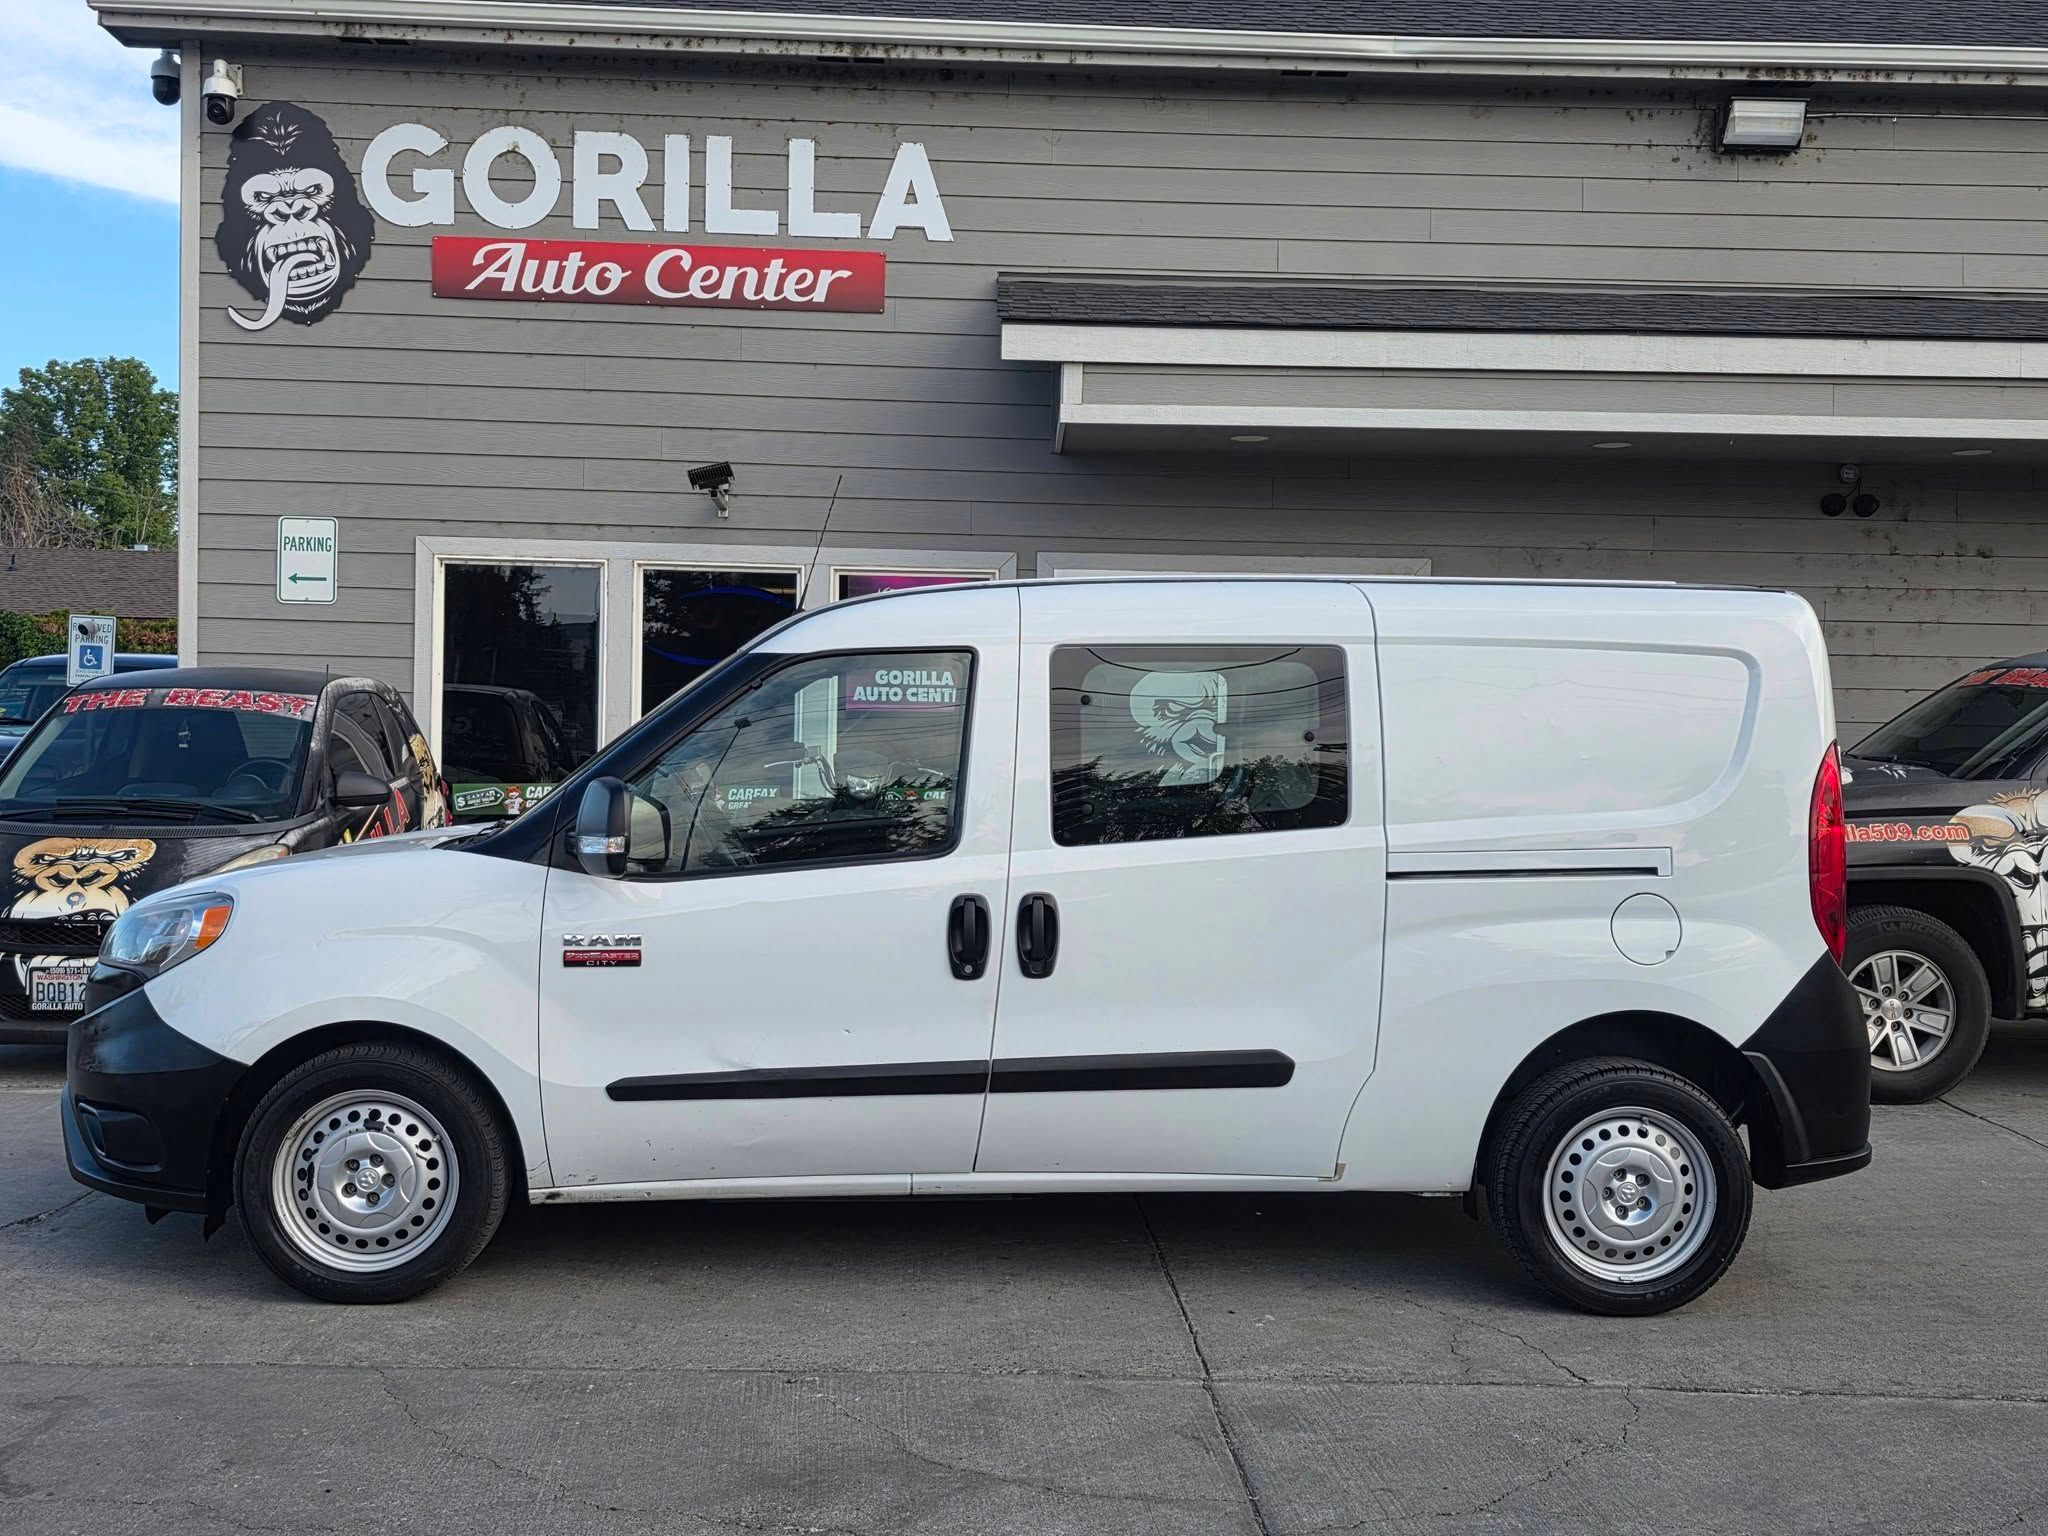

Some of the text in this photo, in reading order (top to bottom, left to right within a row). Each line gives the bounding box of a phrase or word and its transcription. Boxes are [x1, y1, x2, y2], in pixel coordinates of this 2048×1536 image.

[361, 122, 954, 242] GORILLA
[464, 242, 853, 303] Auto Center
[283, 536, 332, 552] PARKING
[75, 633, 109, 645] PARKING
[875, 669, 954, 686] GORILLA
[63, 688, 317, 716] THE BEAST
[853, 686, 904, 702] AUTO
[728, 788, 778, 801] CARFAX
[563, 934, 642, 947] RAM
[32, 1002, 83, 1011] GORILLA AUTO
